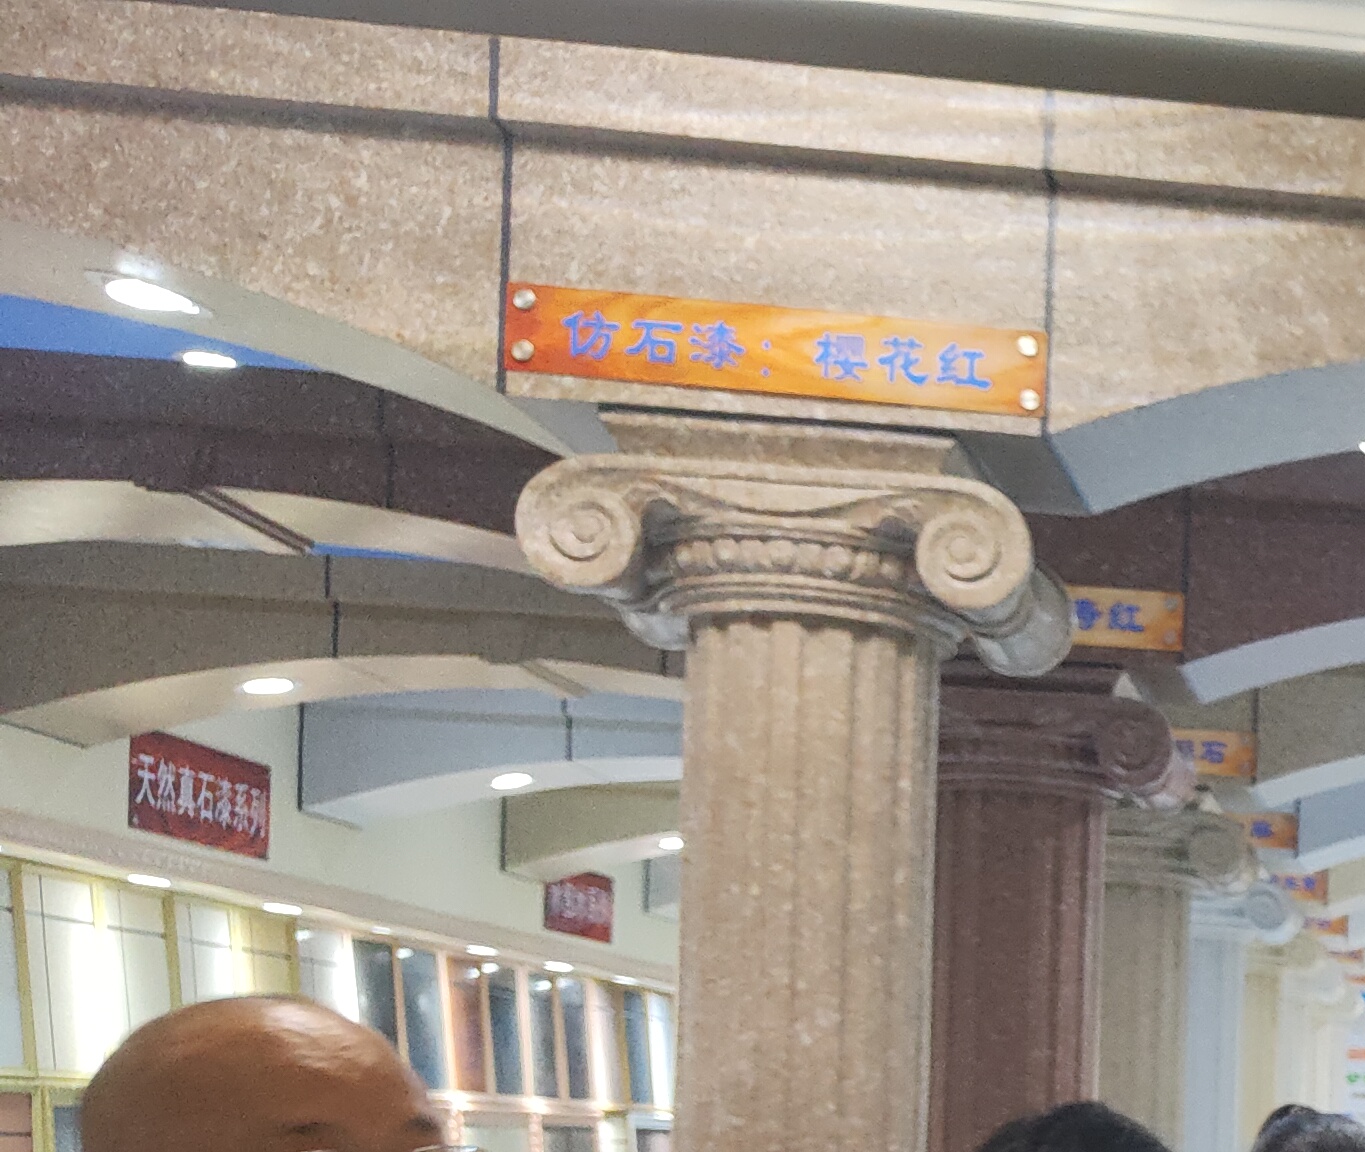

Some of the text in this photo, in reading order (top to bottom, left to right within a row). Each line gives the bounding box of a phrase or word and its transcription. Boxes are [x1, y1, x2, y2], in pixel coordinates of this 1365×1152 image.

[134, 752, 268, 838] 天然真石漆系列
